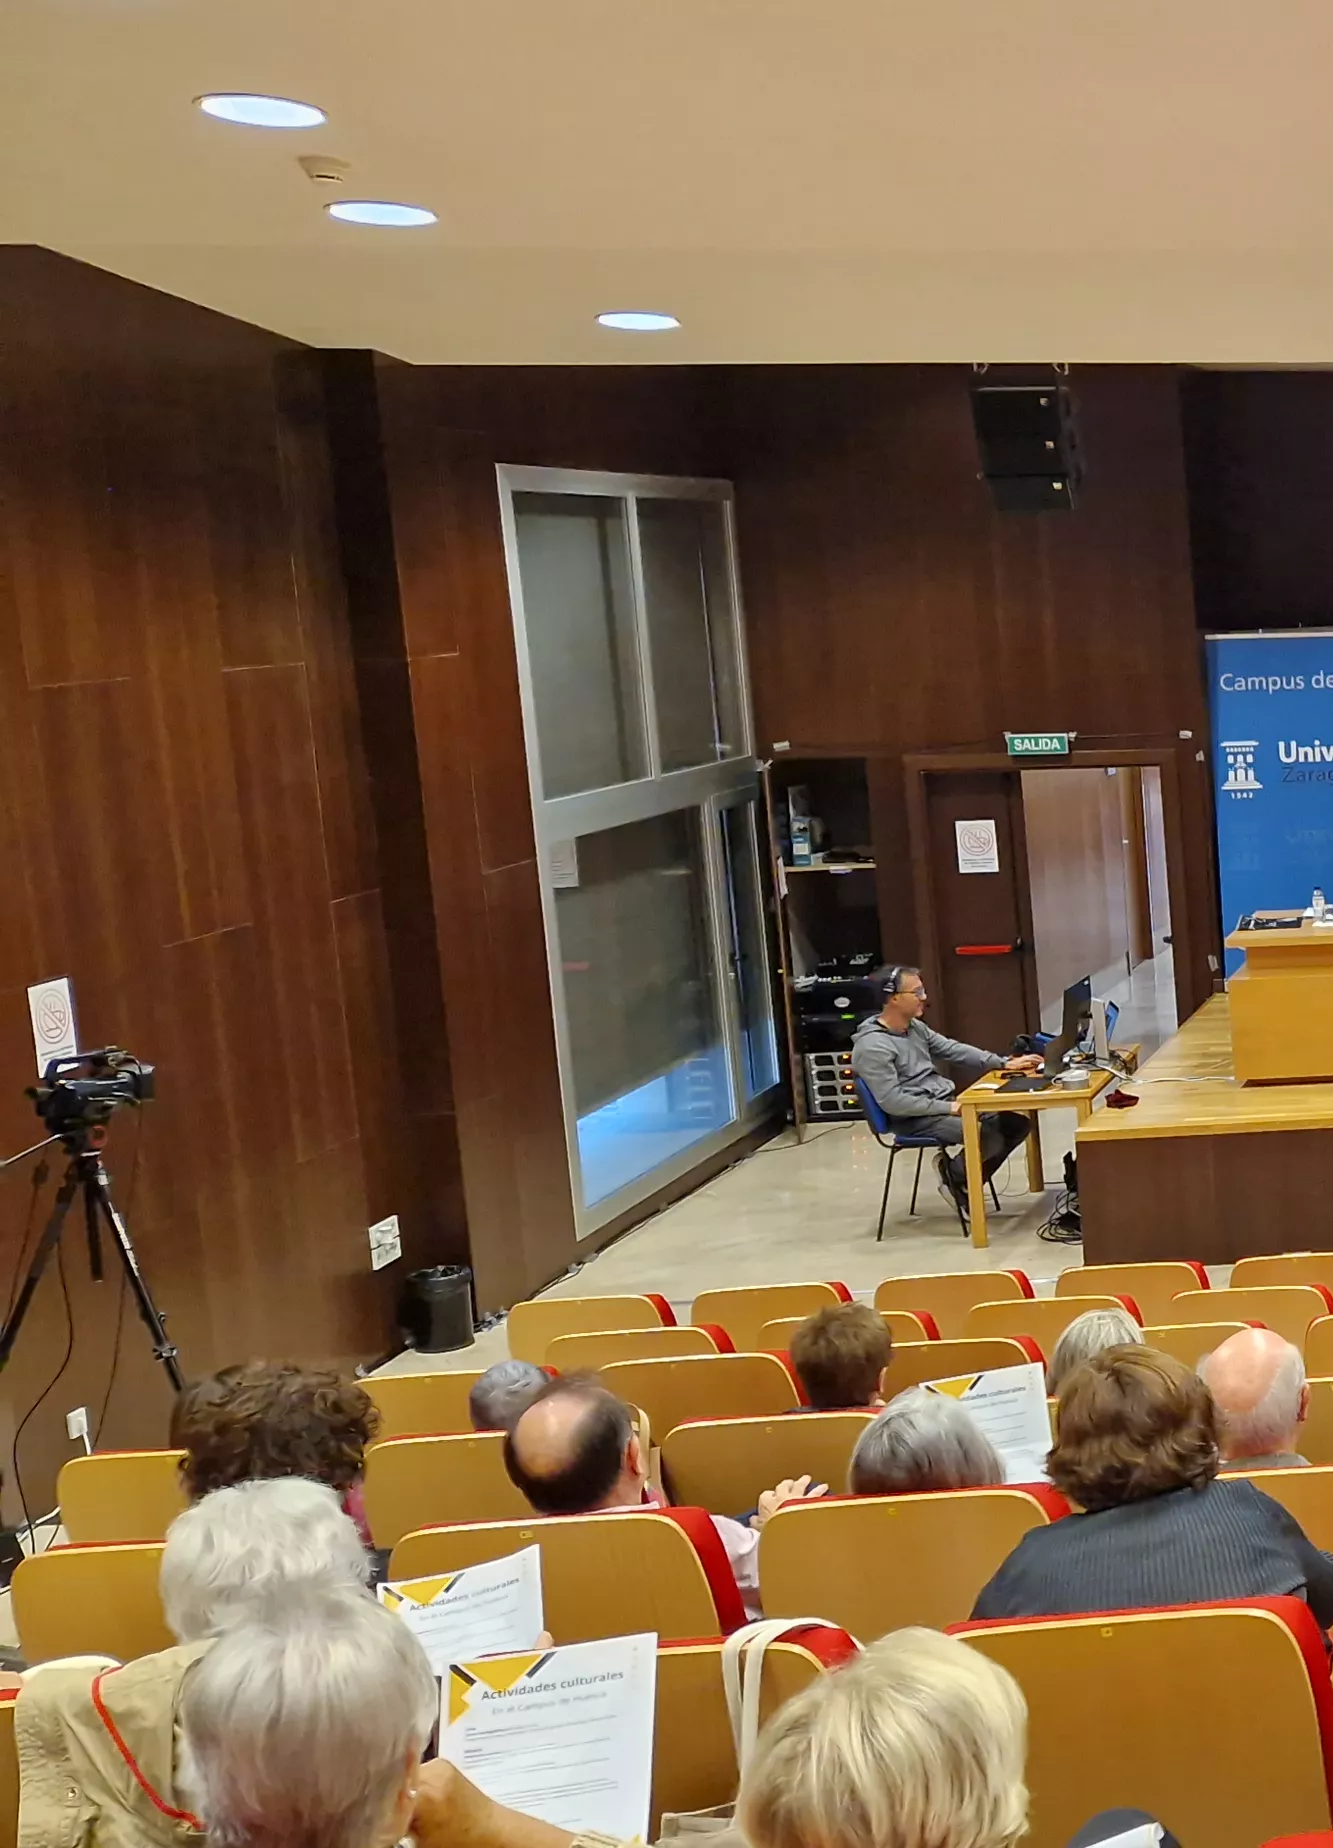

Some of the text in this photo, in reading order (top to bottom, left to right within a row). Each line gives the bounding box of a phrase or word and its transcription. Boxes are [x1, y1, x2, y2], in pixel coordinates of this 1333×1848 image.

[1220, 673, 1304, 695] Campus
[1013, 738, 1061, 751] SALIDA
[481, 1671, 624, 1700] Actividades culturales
